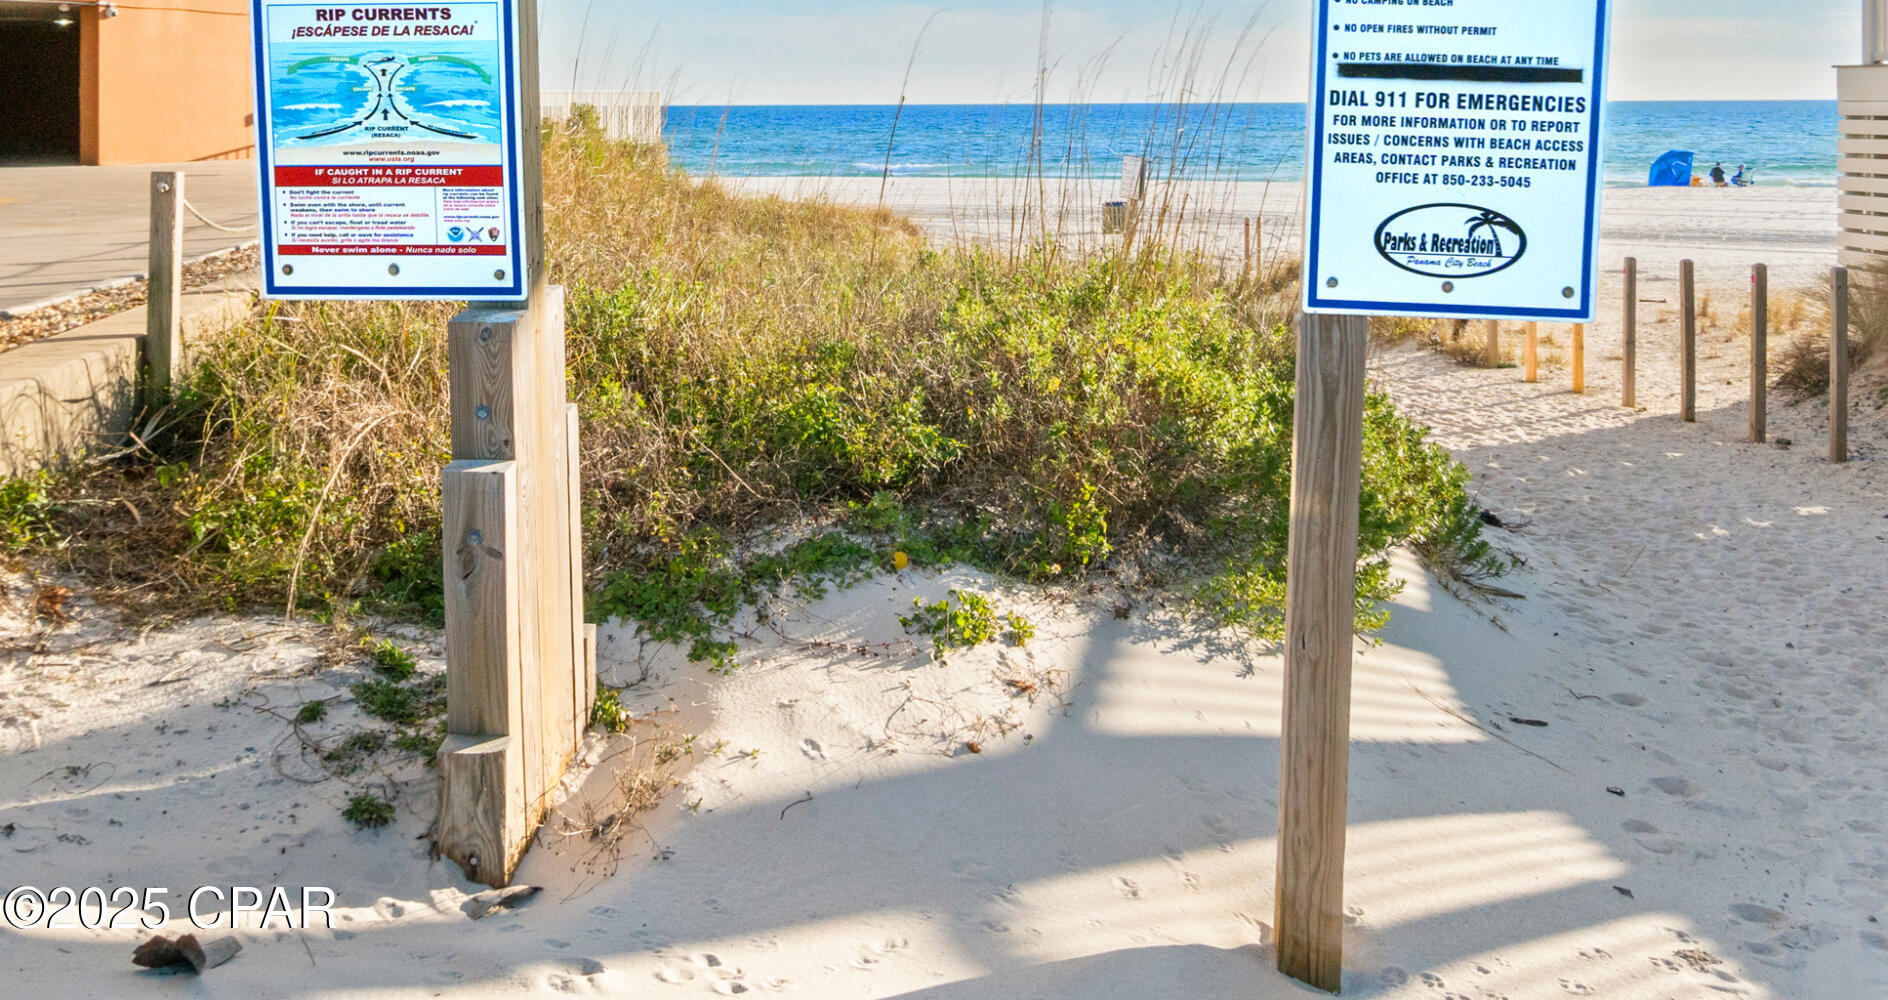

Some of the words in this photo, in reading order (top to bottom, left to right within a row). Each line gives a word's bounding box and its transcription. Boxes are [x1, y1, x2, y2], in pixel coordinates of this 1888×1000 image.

[316, 9, 346, 21] RIP
[351, 7, 451, 21] CURRENTS
[291, 23, 369, 40] ¡ESCÁPESE
[371, 25, 390, 36] DE
[393, 25, 410, 36] LA
[413, 25, 474, 36] RESACA!
[1344, 23, 1357, 32] NO
[1360, 24, 1384, 33] OPEN
[1387, 24, 1414, 34] FIRES
[1416, 25, 1459, 35] WITHOUT
[1461, 26, 1497, 36] PERMIT
[1329, 90, 1369, 107] DIAL
[1375, 91, 1406, 108] 911
[1415, 92, 1450, 109] FOR
[1457, 93, 1586, 113] EMERGENCIES
[1333, 114, 1357, 126] FOR
[1361, 115, 1396, 127] MORE
[1400, 116, 1485, 130] INFORMATION
[1490, 119, 1507, 131] OR
[1511, 119, 1527, 131] TO
[1531, 120, 1580, 133] REPORT
[342, 150, 440, 158] www.ripcurrents.noaa.gov
[1334, 152, 1376, 166] AREAS,
[1381, 153, 1437, 166] CONTACT
[1441, 155, 1481, 168] PARKS
[1485, 156, 1494, 168] &
[1498, 157, 1576, 171] RECREATION
[327, 168, 369, 176] CAUGHT
[415, 168, 463, 176] CURRENT
[1376, 171, 1419, 184] OFFICE
[1423, 173, 1438, 185] AT
[1442, 174, 1531, 188] 850-233-5045
[311, 246, 340, 254] Never
[342, 246, 368, 254] swim
[370, 246, 397, 254] alone
[405, 246, 433, 254] Nunca
[1384, 232, 1417, 252] Parks
[1419, 233, 1428, 253] &
[1431, 234, 1495, 255] Recreation
[1407, 256, 1442, 266] Panama
[1445, 257, 1464, 269] City
[1467, 258, 1493, 268] Beach
